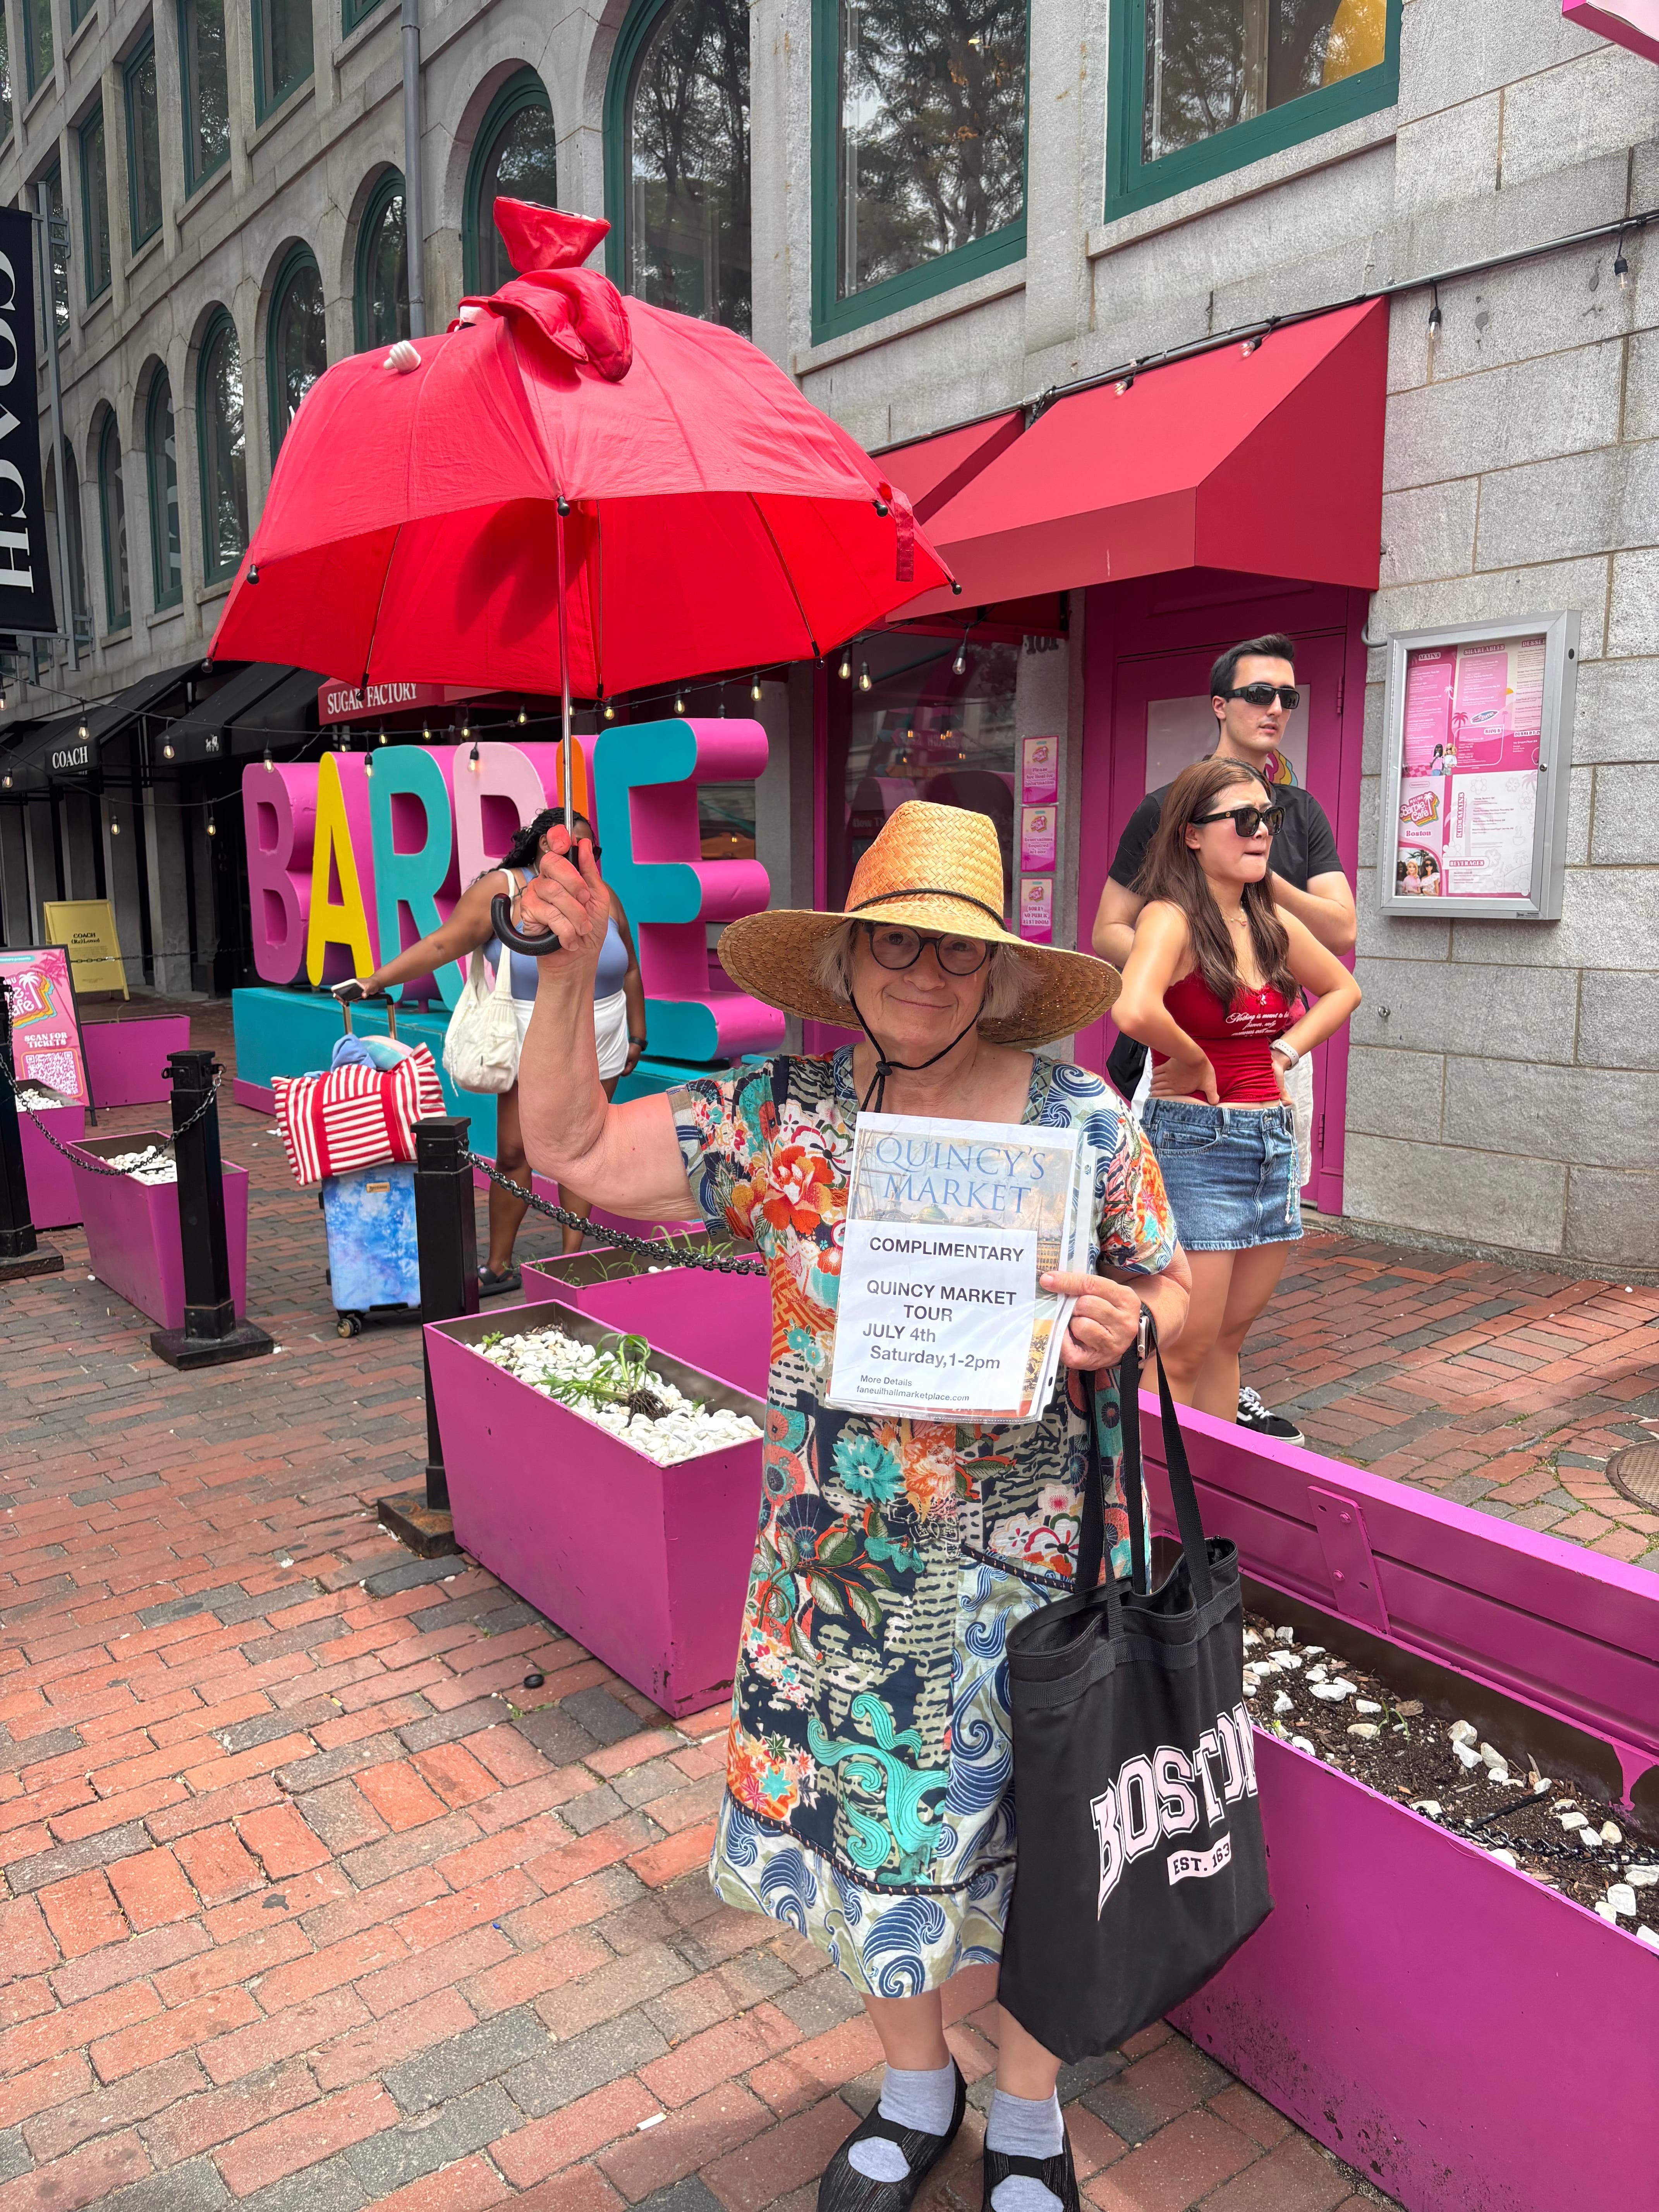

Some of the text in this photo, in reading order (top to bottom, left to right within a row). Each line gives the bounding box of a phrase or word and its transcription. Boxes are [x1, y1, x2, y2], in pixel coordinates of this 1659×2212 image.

[1464, 644, 1504, 655] SHAREABLES
[367, 683, 417, 707] FACTORY
[52, 746, 88, 769] COACH
[1400, 801, 1425, 817] Barbie
[1226, 1012, 1255, 1023] Nothing
[24, 1032, 67, 1042] SCAN FOR
[27, 1039, 66, 1048] TICKETS
[876, 1137, 1045, 1180] QUINCY'S
[882, 1174, 1031, 1214] MARKET
[869, 1237, 1024, 1262] COMPLIMENTARY
[867, 1280, 1017, 1306] QUINCY MARKET
[903, 1304, 953, 1322] TOUR
[863, 1323, 936, 1342] JULY 4th
[860, 1375, 912, 1386] More Details
[857, 1386, 969, 1401] faneuilhallmarketplace.com
[1173, 1857, 1207, 1875] EST.
